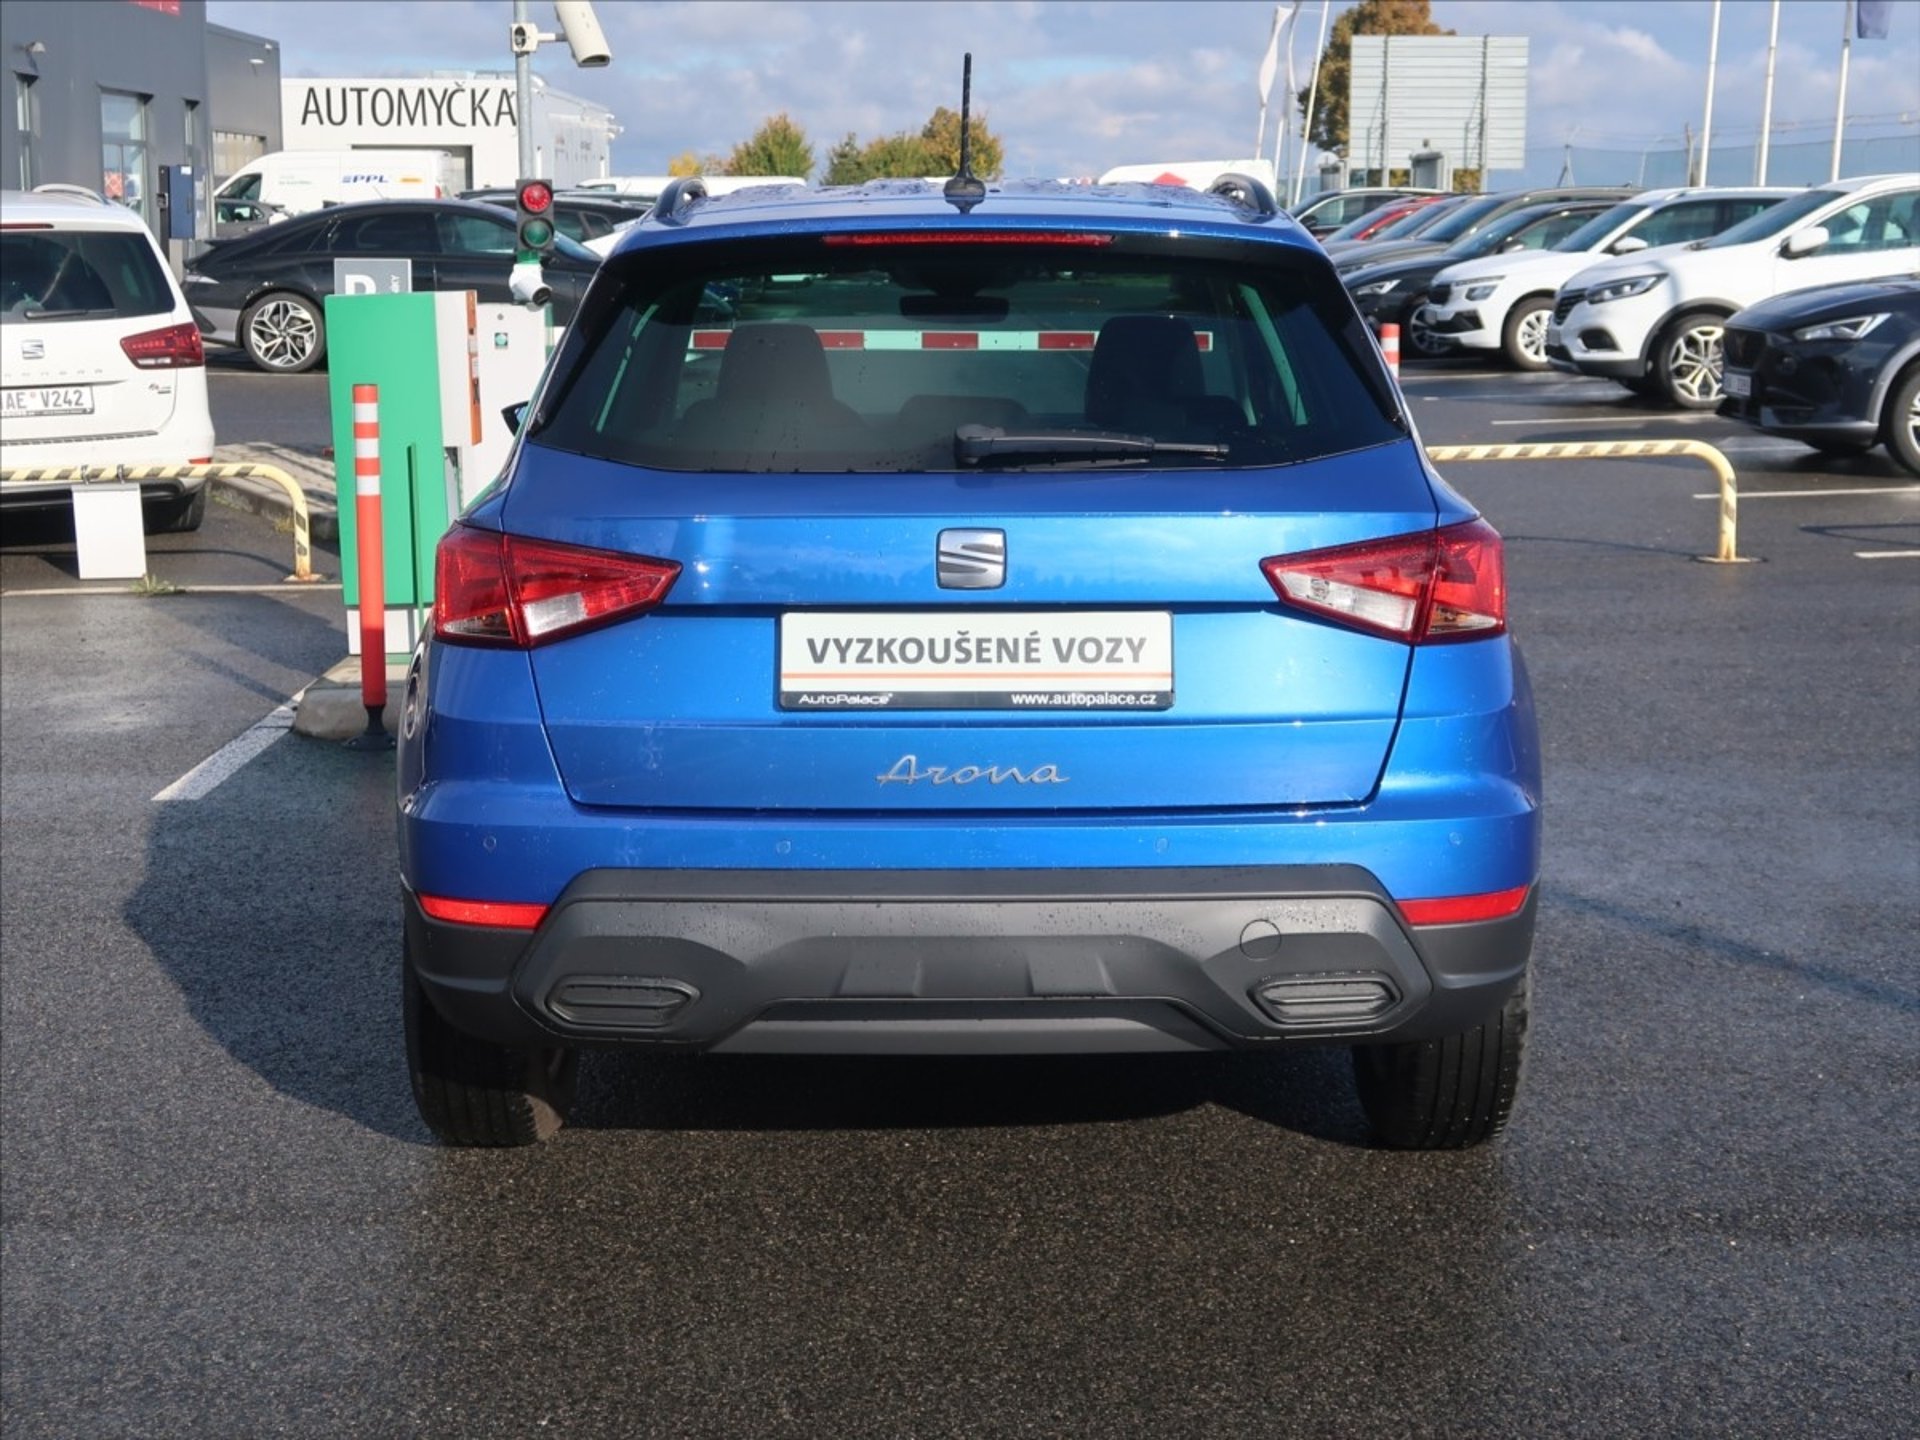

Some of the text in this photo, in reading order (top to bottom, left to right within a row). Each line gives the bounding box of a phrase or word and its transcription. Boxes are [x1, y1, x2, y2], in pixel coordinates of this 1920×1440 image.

[301, 81, 517, 127] AUTOMYČKA
[351, 174, 389, 184] PPL
[0, 389, 84, 411] AE V242
[806, 630, 1148, 665] VYZKOUŠENÉ VOZY
[798, 693, 892, 705] AutoPalace
[1010, 692, 1158, 707] www.autopalace.cz
[875, 753, 1071, 787] Arona
